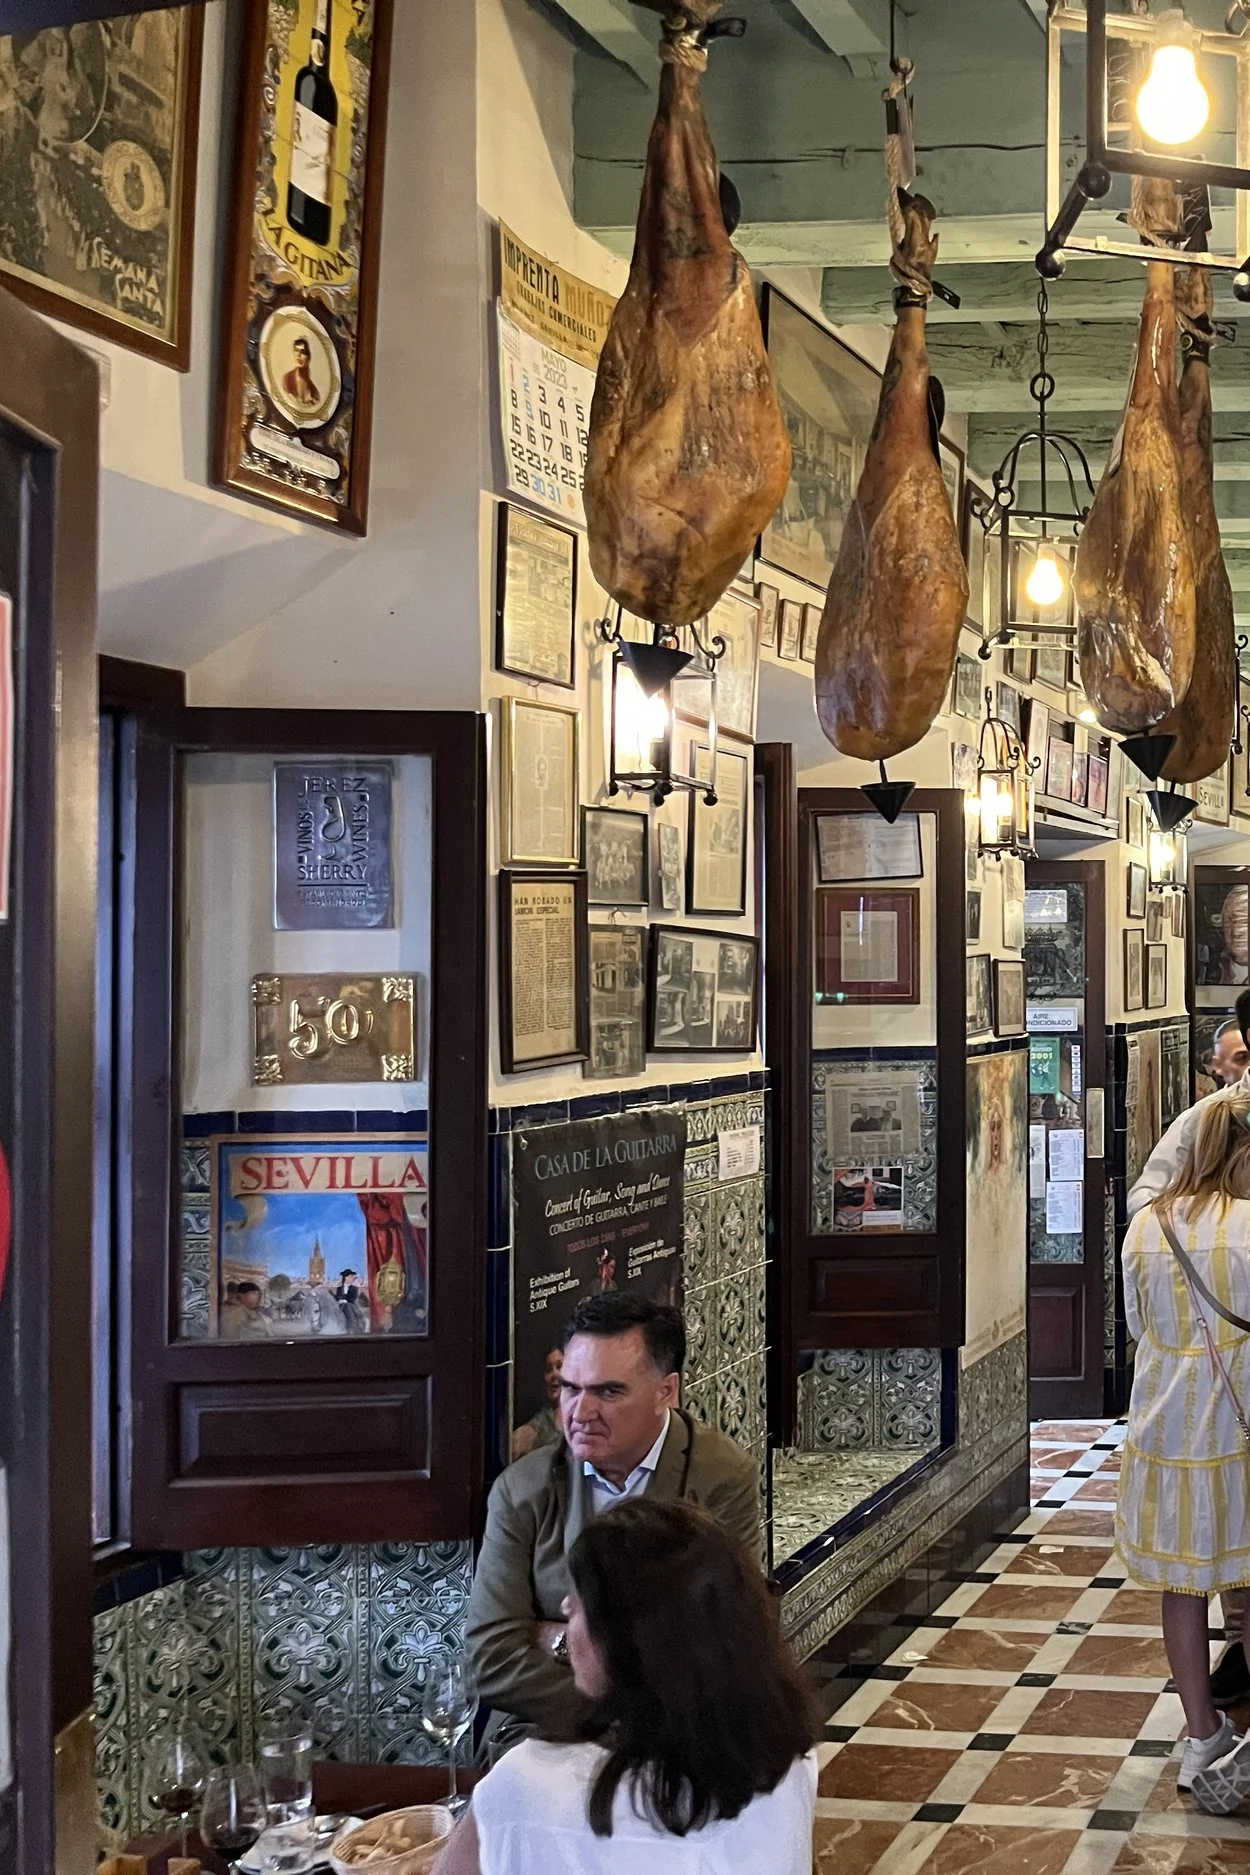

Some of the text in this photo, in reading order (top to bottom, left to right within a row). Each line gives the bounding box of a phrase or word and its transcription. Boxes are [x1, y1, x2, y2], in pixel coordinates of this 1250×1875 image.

[262, 208, 352, 281] LA GITANA
[504, 233, 560, 305] IMPRENTA
[541, 346, 567, 373] MAYO
[544, 364, 568, 391] 2023
[510, 388, 518, 410] 8
[539, 408, 552, 431] 10
[559, 418, 569, 439] 11
[522, 373, 531, 394] 2
[538, 384, 547, 405] 3
[557, 396, 566, 414] 4
[575, 403, 585, 423] 5
[511, 413, 522, 436] 15
[526, 423, 537, 446] 16
[541, 433, 554, 453] 17
[560, 441, 573, 464] 18
[509, 438, 526, 463] 22
[526, 447, 542, 472] 23
[542, 456, 559, 481] 24
[560, 465, 577, 489] 25
[514, 463, 561, 504] 29 30 31
[298, 777, 368, 798] JEREZ
[351, 804, 370, 863] WINES
[298, 865, 369, 880] SHERRY
[1031, 1052, 1054, 1060] 2001
[240, 1156, 427, 1191] SEVILLA
[534, 1135, 678, 1180] CASA DE LA GUITARRA
[545, 1194, 574, 1218] Concert
[549, 1216, 584, 1236] CONCIERTO
[584, 1214, 595, 1226] DE
[629, 1200, 649, 1215] CANTE
[529, 1267, 572, 1289] Exhibition of
[529, 1278, 580, 1301] Antique Guitars
